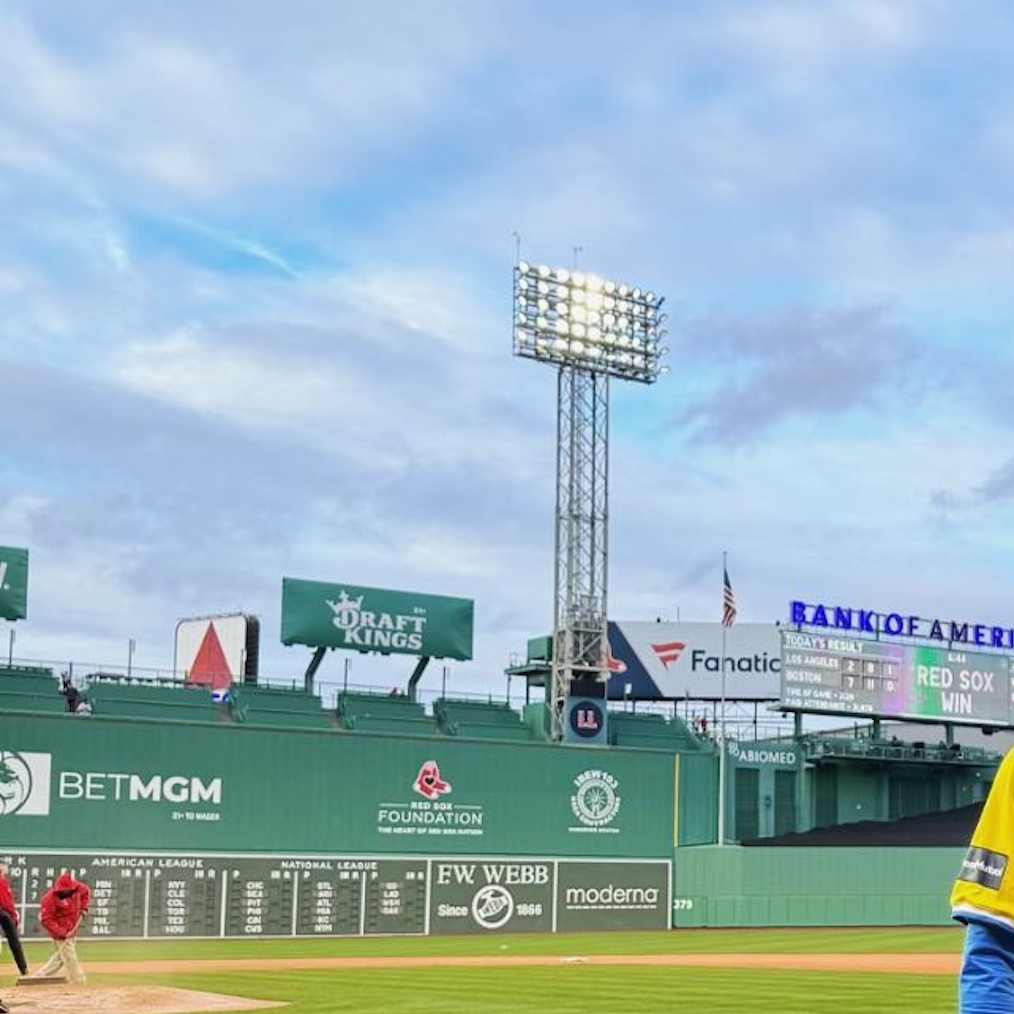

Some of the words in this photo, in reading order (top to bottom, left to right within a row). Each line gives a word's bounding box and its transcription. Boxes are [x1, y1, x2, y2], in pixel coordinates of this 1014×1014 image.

[333, 608, 427, 633] DRAFT
[790, 601, 874, 632] BANK
[884, 613, 919, 636] OF
[343, 626, 423, 650] KINGS
[785, 634, 827, 650] TODAY'S
[828, 639, 862, 652] RESULT
[691, 650, 781, 672] Fanatic
[804, 656, 839, 669] ANGELES
[847, 660, 855, 672] 2
[785, 669, 822, 683] BOSTON
[917, 665, 953, 688] RED
[959, 669, 994, 692] SOX
[942, 692, 973, 714] WIN
[739, 749, 796, 764] ABIOMED
[59, 771, 222, 804] BETMGM
[410, 801, 431, 810] RED
[433, 802, 453, 811] SOX
[378, 809, 483, 825] FOUNDATION
[92, 858, 153, 867] AMERICAN
[159, 858, 204, 868] LEAGUE
[281, 860, 333, 870] NATIONAL
[337, 861, 378, 870] LEAGUE
[483, 864, 549, 884] WEBB
[566, 884, 659, 905] moderna
[437, 903, 469, 917] Since
[516, 903, 543, 917] 1866
